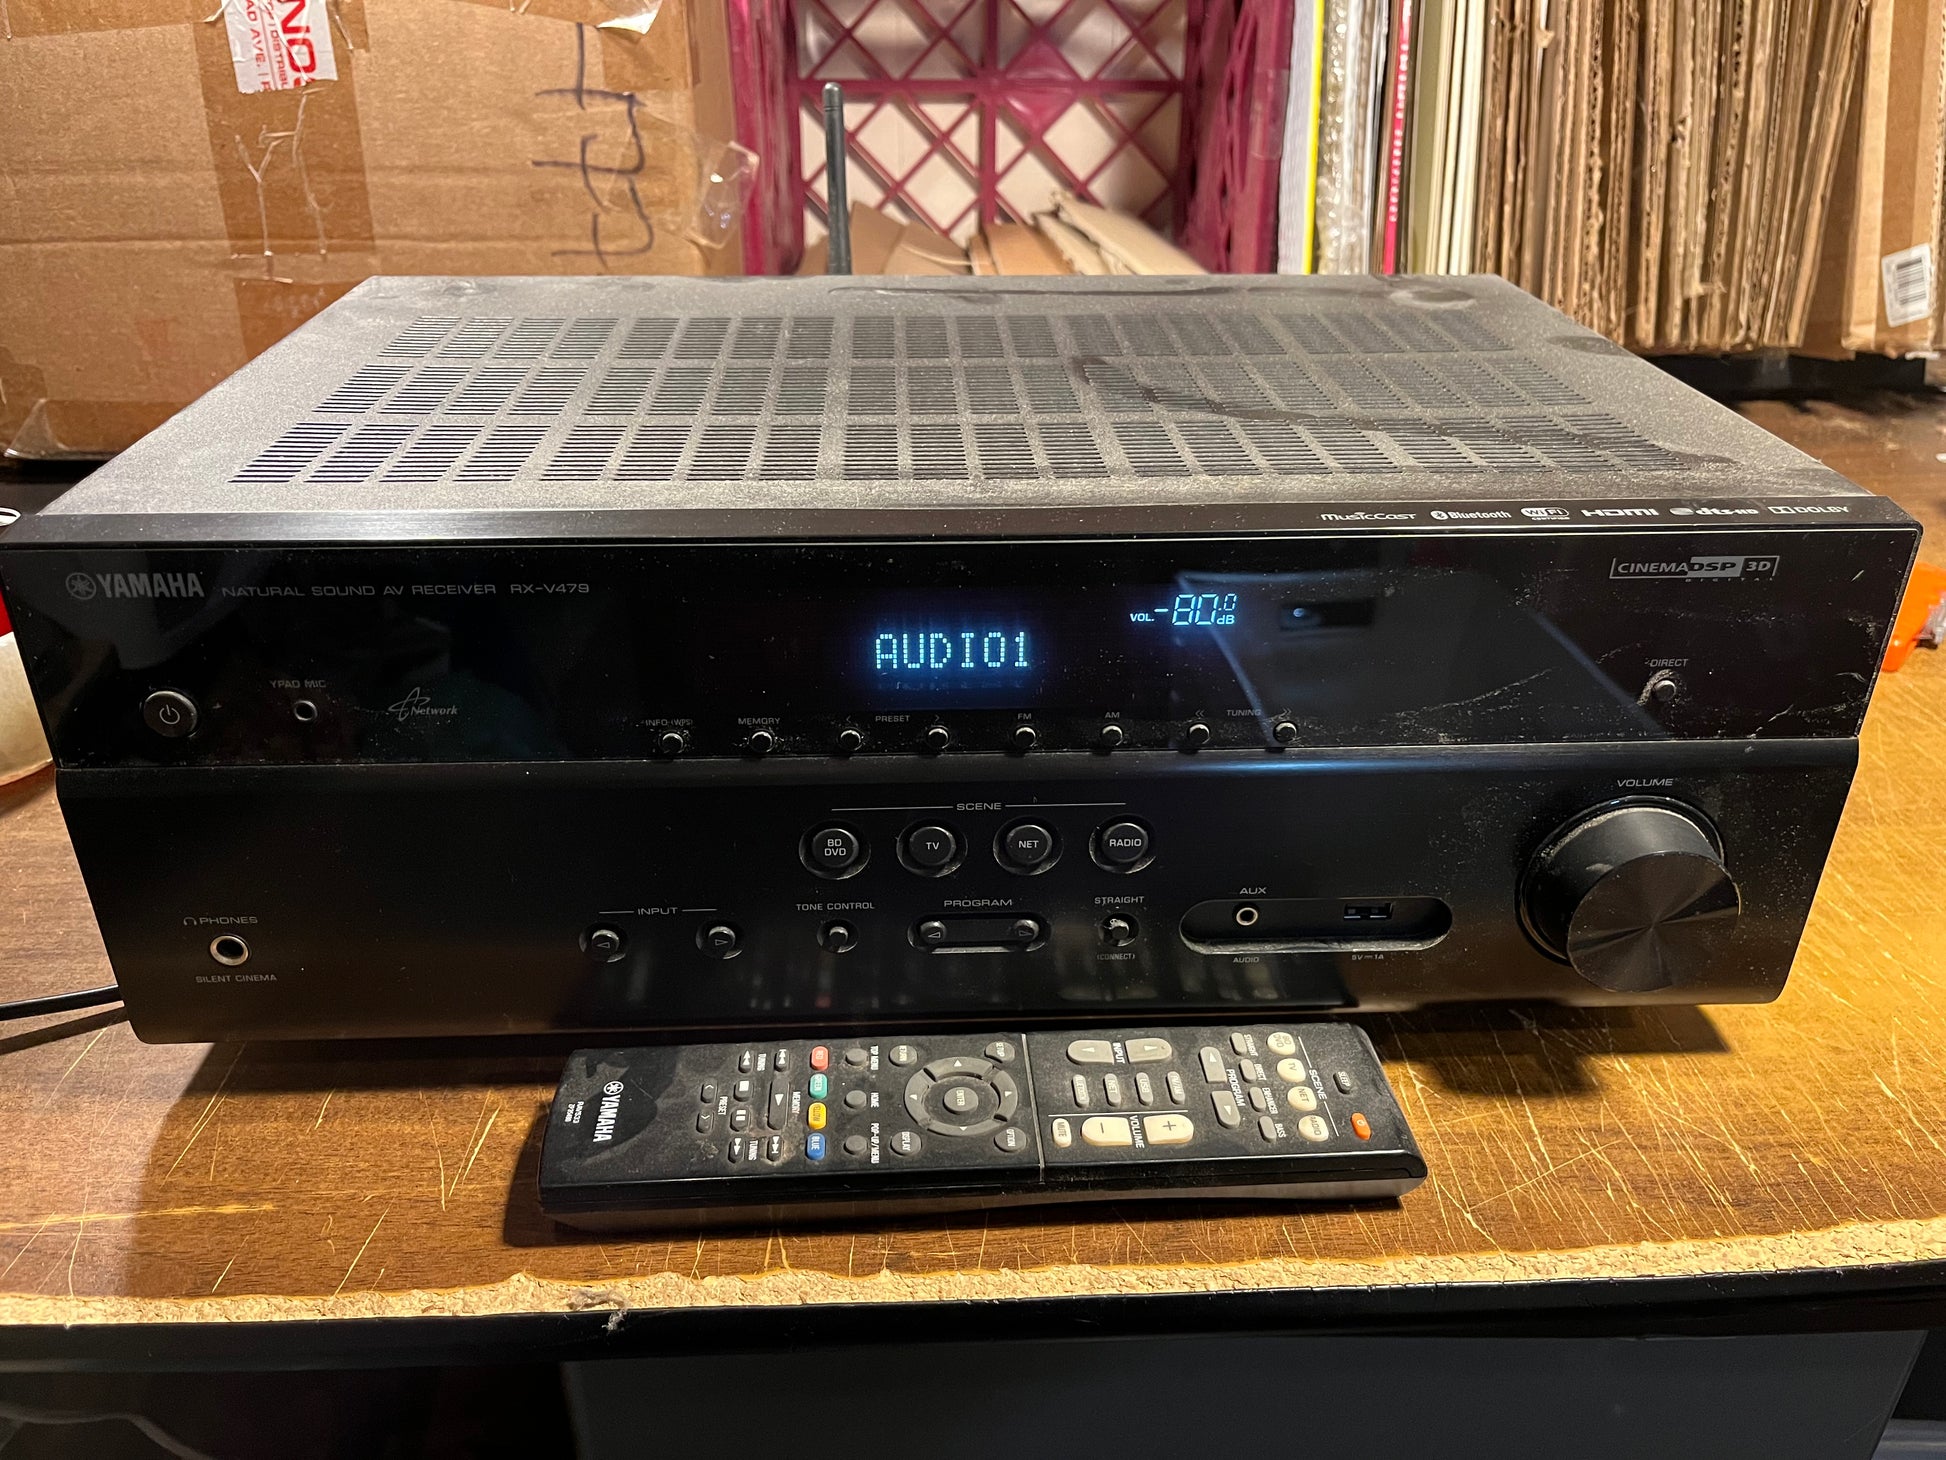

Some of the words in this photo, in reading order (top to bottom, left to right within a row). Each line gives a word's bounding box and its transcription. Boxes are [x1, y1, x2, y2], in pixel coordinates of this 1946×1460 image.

[1449, 509, 1512, 520] Bluetooth
[1581, 508, 1660, 517] HDMI
[1797, 505, 1850, 514] DOLBY
[1745, 561, 1772, 572] 3D
[98, 572, 205, 599] YAMAHA
[221, 586, 305, 597] NATURAL
[311, 585, 376, 596] SOUND
[382, 584, 404, 595] AV
[411, 584, 497, 595] RECEIVER
[510, 582, 591, 593] RX-V479
[1129, 612, 1155, 622] VOL.
[1216, 614, 1235, 625] dB
[875, 631, 1029, 670] AUDIO1
[1649, 658, 1689, 668] DIRECT
[304, 679, 327, 688] MIC
[411, 704, 458, 717] Network
[1104, 711, 1120, 719] AM
[1226, 709, 1262, 717] TUNING
[875, 714, 910, 723] PRESET
[1017, 712, 1032, 720] FM
[645, 719, 668, 727] INFO
[737, 717, 781, 726] MEMORY
[1616, 778, 1674, 788] VOLUME
[956, 802, 1003, 811] SCENE
[827, 838, 842, 847] BD
[926, 841, 940, 851] TV
[1018, 840, 1040, 849] NET
[1109, 838, 1142, 848] RADIO
[824, 847, 847, 857] DVD
[1239, 886, 1268, 895] AUX
[943, 898, 1013, 908] PROGRAM
[1094, 896, 1145, 905] STRAIGHT
[637, 906, 679, 916] INPUT
[796, 903, 824, 912] TONE
[826, 901, 875, 911] CONTROL
[200, 916, 258, 925] PHONES
[1232, 956, 1260, 964] AUDIO
[195, 974, 231, 983] SILENT
[235, 973, 278, 982] CINEMA
[870, 1045, 879, 1056] TOP
[1112, 1042, 1126, 1064] INPUT
[1286, 1061, 1298, 1072] TV
[1139, 1078, 1150, 1093] USB
[1226, 1069, 1246, 1107] PROGRAM
[1308, 1069, 1328, 1100] SCENE
[1297, 1088, 1310, 1103] NET
[718, 1096, 728, 1115] PRESET
[593, 1094, 621, 1142] YAMAHA
[1056, 1121, 1068, 1138] MUTE
[1129, 1115, 1146, 1149] VOLUME
[811, 1136, 820, 1150] BLUE
